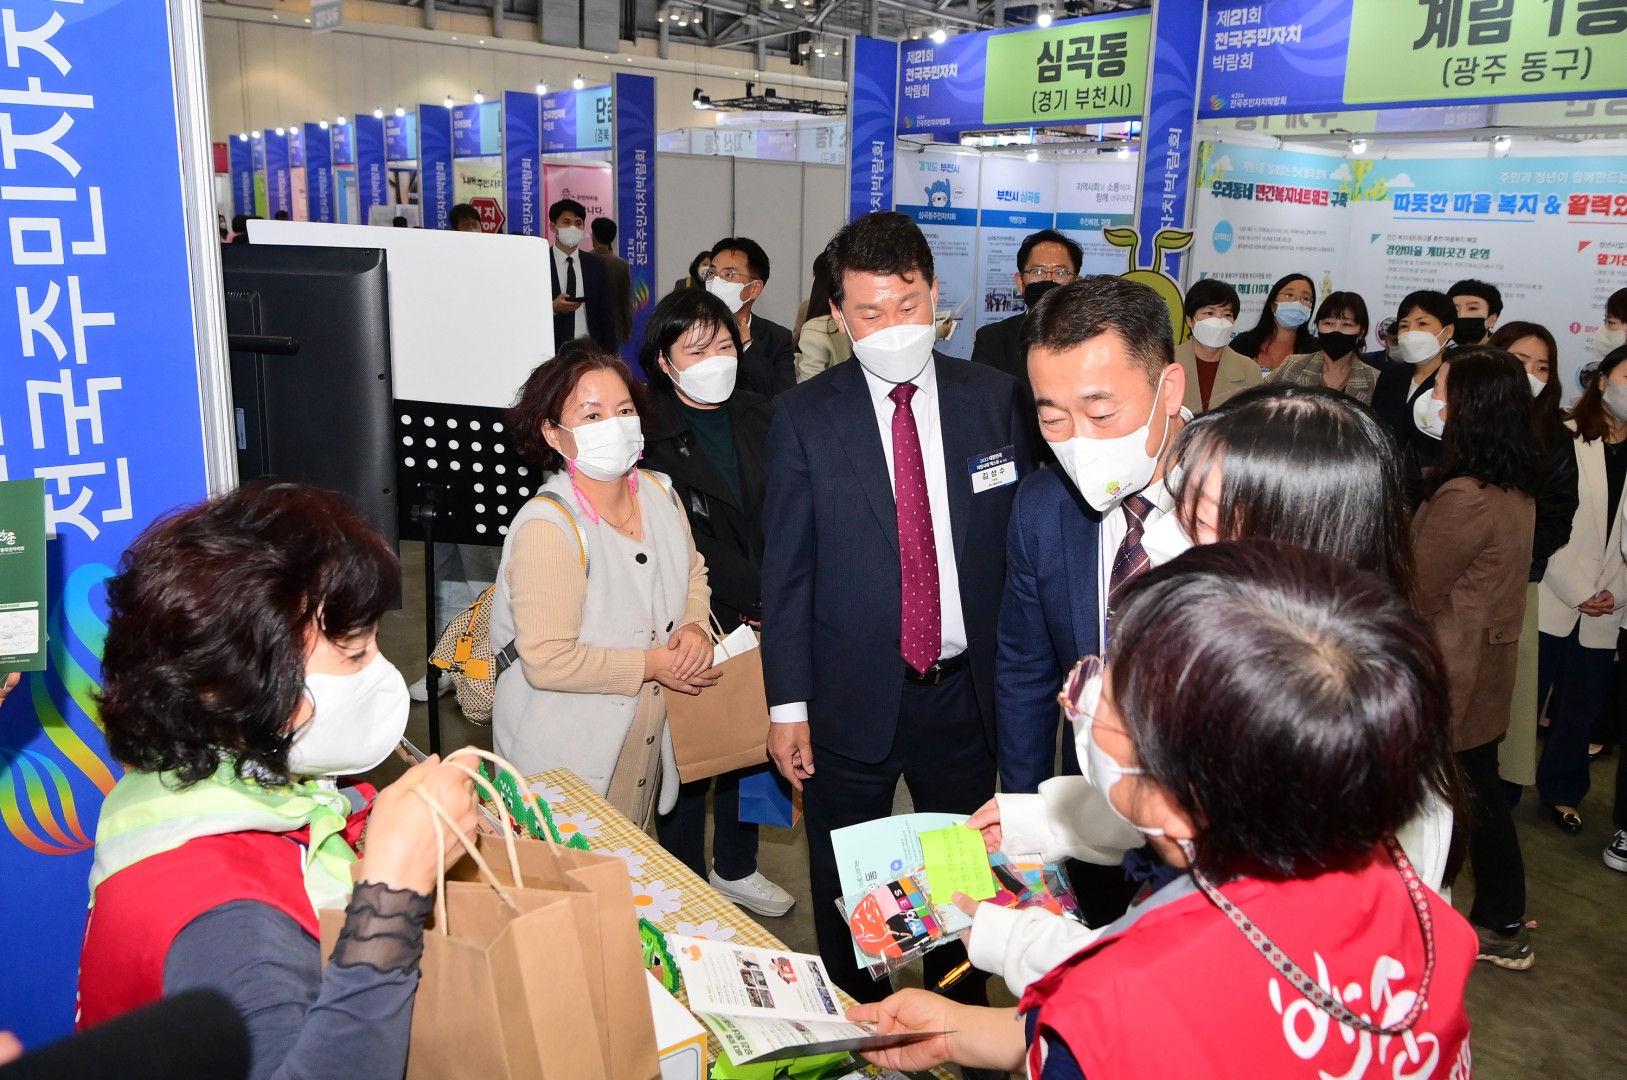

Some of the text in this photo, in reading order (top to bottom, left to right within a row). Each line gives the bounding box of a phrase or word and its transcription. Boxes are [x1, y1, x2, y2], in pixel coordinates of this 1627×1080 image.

[1216, 5, 1262, 27] 제21회
[1413, 0, 1514, 50] 계림
[1215, 24, 1302, 51] 전국주민자치
[906, 48, 934, 64] 제21회
[1037, 31, 1128, 83] 심곡동
[1213, 51, 1253, 72] 박람회
[905, 63, 958, 82] 전국주민자치
[1443, 46, 1592, 88] (광주 동구)
[905, 83, 930, 99] 박람회
[1032, 83, 1132, 113] (경기 부천시)
[1230, 96, 1287, 109] 전국주민자치박람회
[918, 161, 960, 173] 경기도 부천시
[1500, 171, 1627, 184] 주민과 청년이 함께만드는
[996, 190, 1040, 203] 부천시 심곡동
[1096, 193, 1108, 202] 함께
[1255, 184, 1329, 207] 민간복지네트워크
[1330, 191, 1349, 208] 구축
[1393, 192, 1448, 213] 따뜻한
[1453, 192, 1492, 214] 마을
[1498, 193, 1538, 215] 복지
[1543, 195, 1562, 214] &
[635, 149, 648, 266] 전국주민자치박람회
[918, 211, 957, 221] 심곡동주민자치회
[1386, 244, 1491, 260] 경양마을 개미곳간 운영
